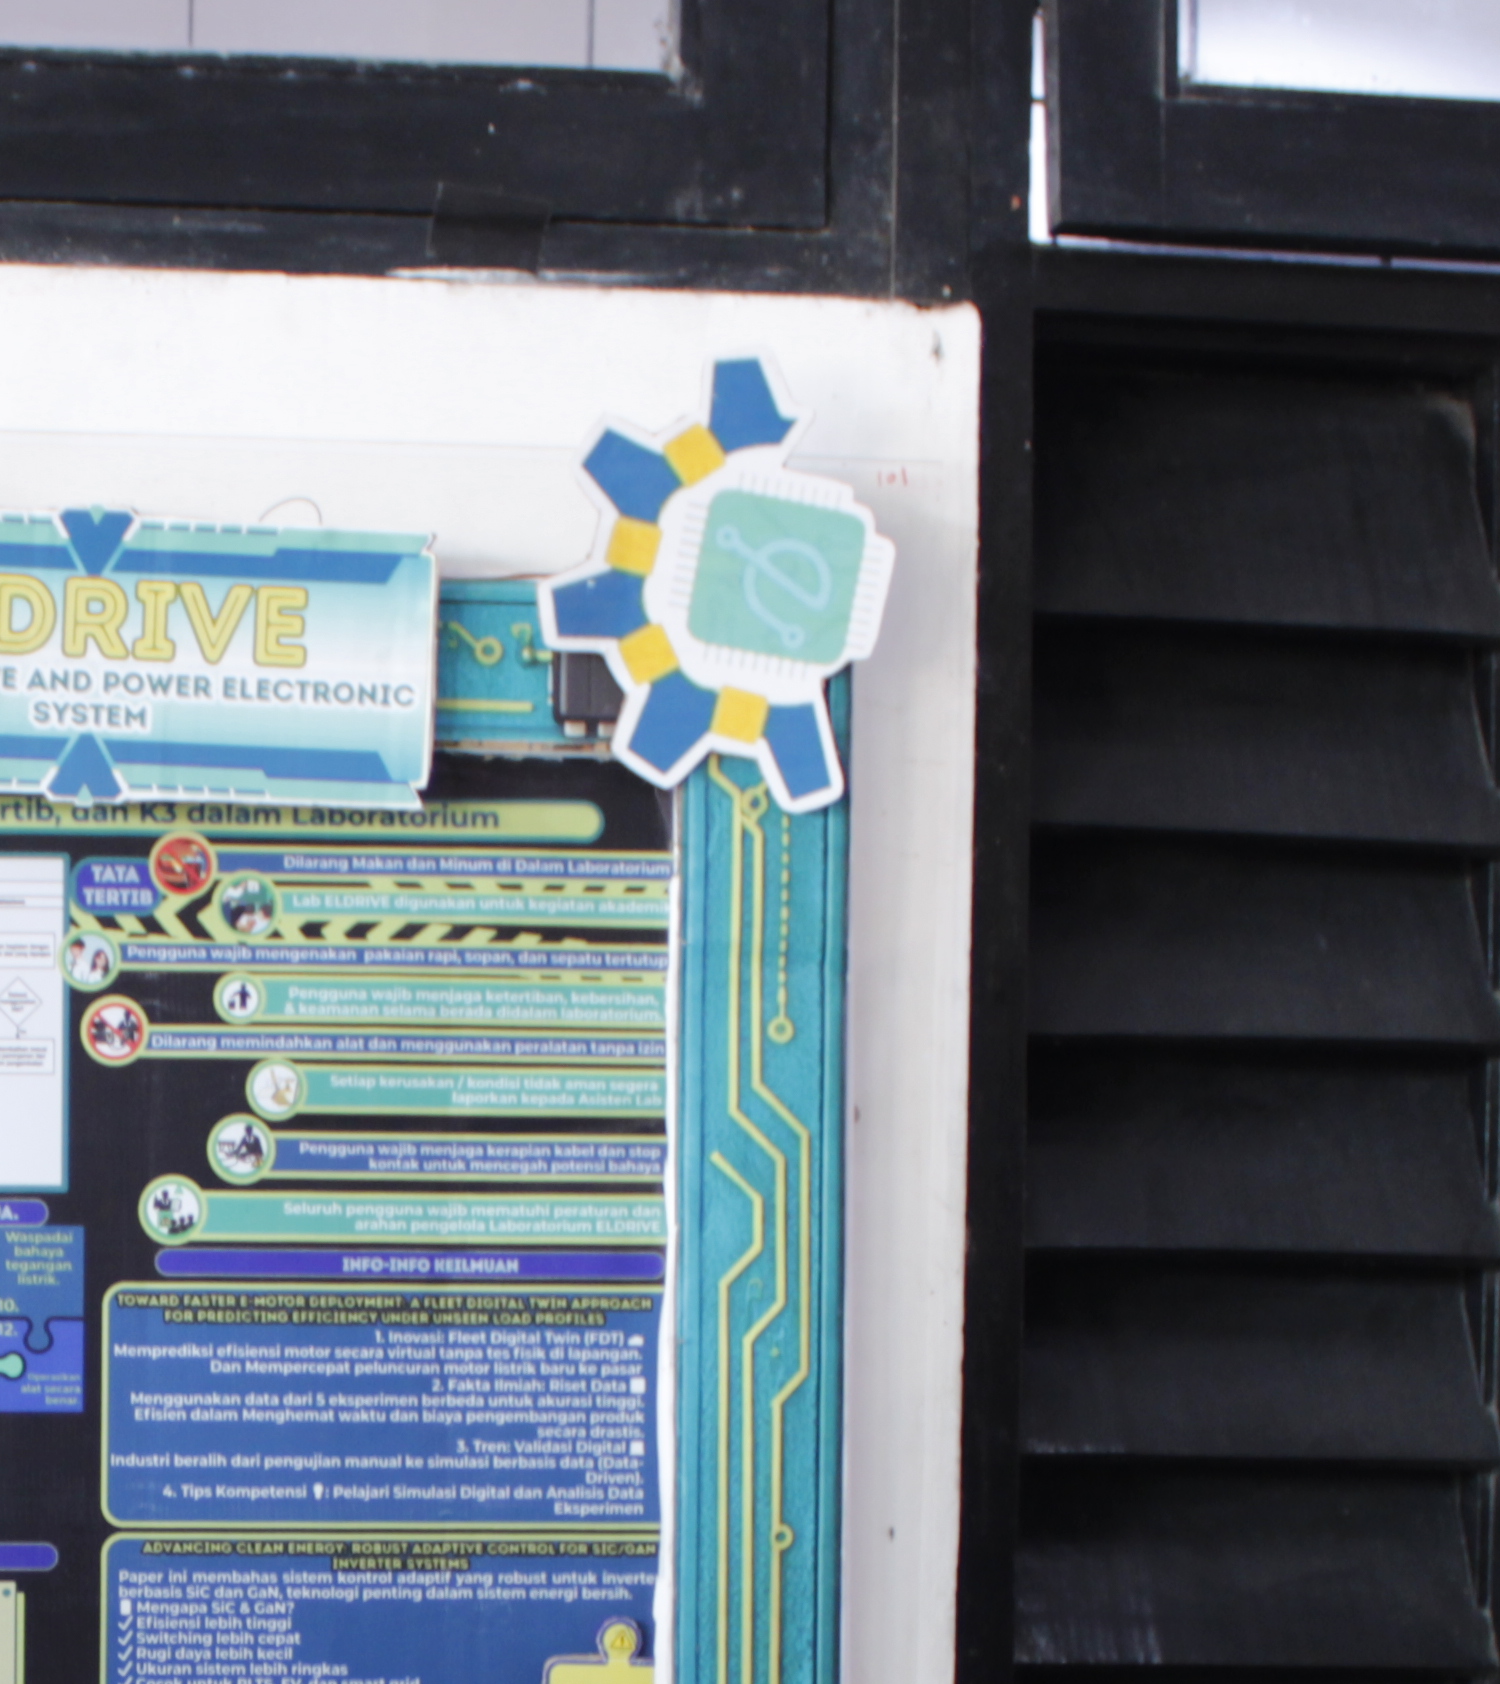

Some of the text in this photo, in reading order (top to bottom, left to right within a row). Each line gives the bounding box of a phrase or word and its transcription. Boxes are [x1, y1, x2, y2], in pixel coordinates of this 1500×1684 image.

[27, 666, 91, 694] AND
[103, 669, 210, 699] POWER
[222, 674, 414, 708] ELECTRONIC
[31, 701, 149, 729] SYSTEM
[69, 805, 131, 823] dan
[140, 803, 179, 824] K3
[186, 804, 281, 826] dalam
[292, 804, 499, 830] Laboratorium
[284, 855, 671, 874] Dilarang Makan dan Minum di Dalam Laboratorium
[91, 865, 139, 884] TATA
[83, 888, 154, 907] TERTIB
[127, 945, 669, 970] Pengguna wajib mengenakan pakaian rapi, sopan, dan sepatu tertutup
[152, 1034, 666, 1056] Dilarang memindahkan alat dan menggunakan peralatan tanpa izin
[5, 1232, 73, 1245] Waspadai
[14, 1245, 64, 1259] bahaya
[5, 1260, 72, 1274] tegangan
[342, 1257, 518, 1274] INFO-INFO KEILMUAN
[17, 1274, 59, 1285] listrik.
[375, 1330, 623, 1346] 1. Inovasi: Fleet Digital Twin (FDT)
[137, 1600, 294, 1617] Mengapa SiC & GaN?
[137, 1616, 291, 1632] Efisiensi lebih tinggi
[137, 1631, 300, 1647] Switching lebih cepat
[137, 1647, 292, 1662] Rugi daya lebih kecil
[136, 1662, 347, 1678] Ukuran sistem lebih ringkas
